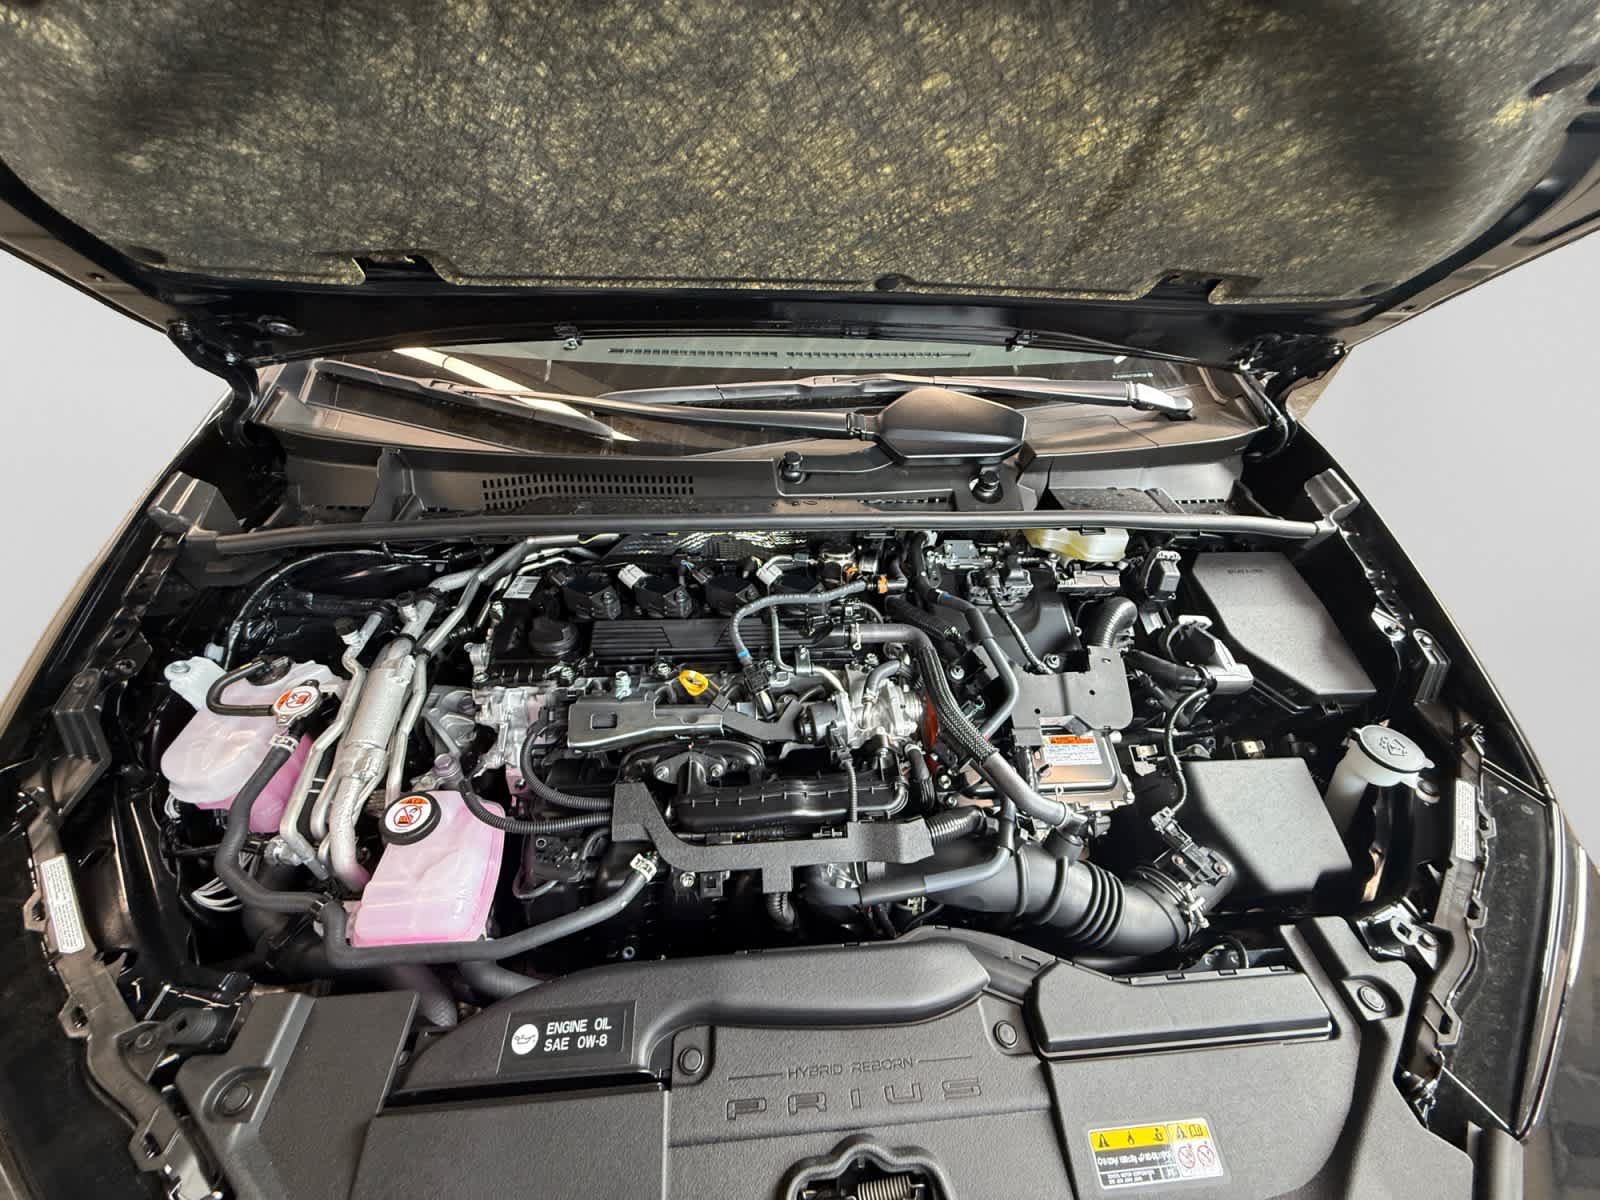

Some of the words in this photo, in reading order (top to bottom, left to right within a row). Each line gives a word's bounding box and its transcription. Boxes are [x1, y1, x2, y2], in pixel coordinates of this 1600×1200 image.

[546, 1019, 588, 1035] ENGINE
[594, 1017, 612, 1031] OIL
[543, 1037, 570, 1052] SAE
[577, 1034, 608, 1049] 0W-8
[787, 1063, 843, 1080] HYBRID
[851, 1055, 914, 1073] REBORN
[726, 1076, 982, 1121] PRIUS
